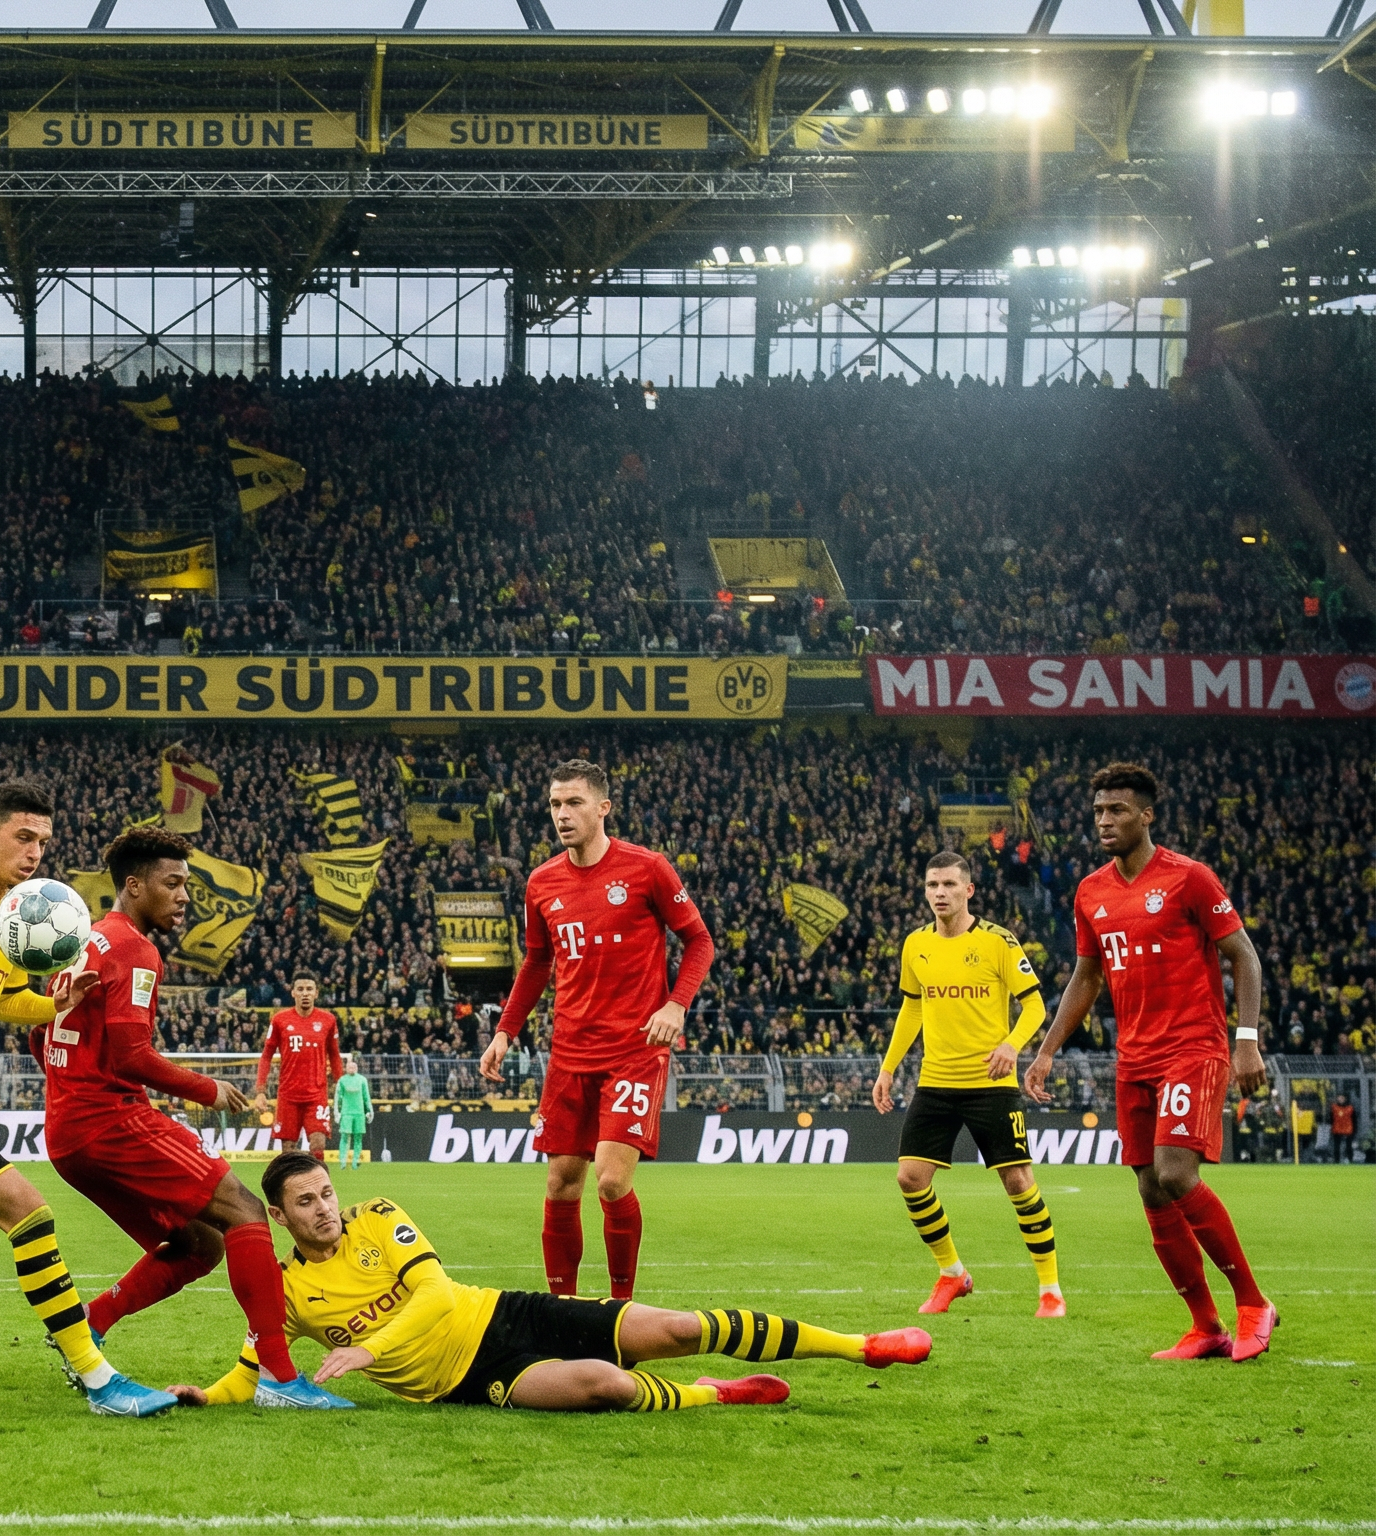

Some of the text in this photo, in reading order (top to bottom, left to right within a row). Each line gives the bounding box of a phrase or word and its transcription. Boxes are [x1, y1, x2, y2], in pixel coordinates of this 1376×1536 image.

[42, 113, 314, 147] SÜDTRIBÜNE
[449, 115, 662, 146] SÜDTRIBÜNE
[235, 658, 690, 713] SÜDTRIBÜNE
[724, 666, 767, 698] BVB
[876, 658, 1317, 710] MIA SAN MIA
[927, 985, 990, 999] EVONIK
[611, 1080, 650, 1117] 25
[696, 1112, 849, 1164] bwin
[978, 1112, 1123, 1164] win
